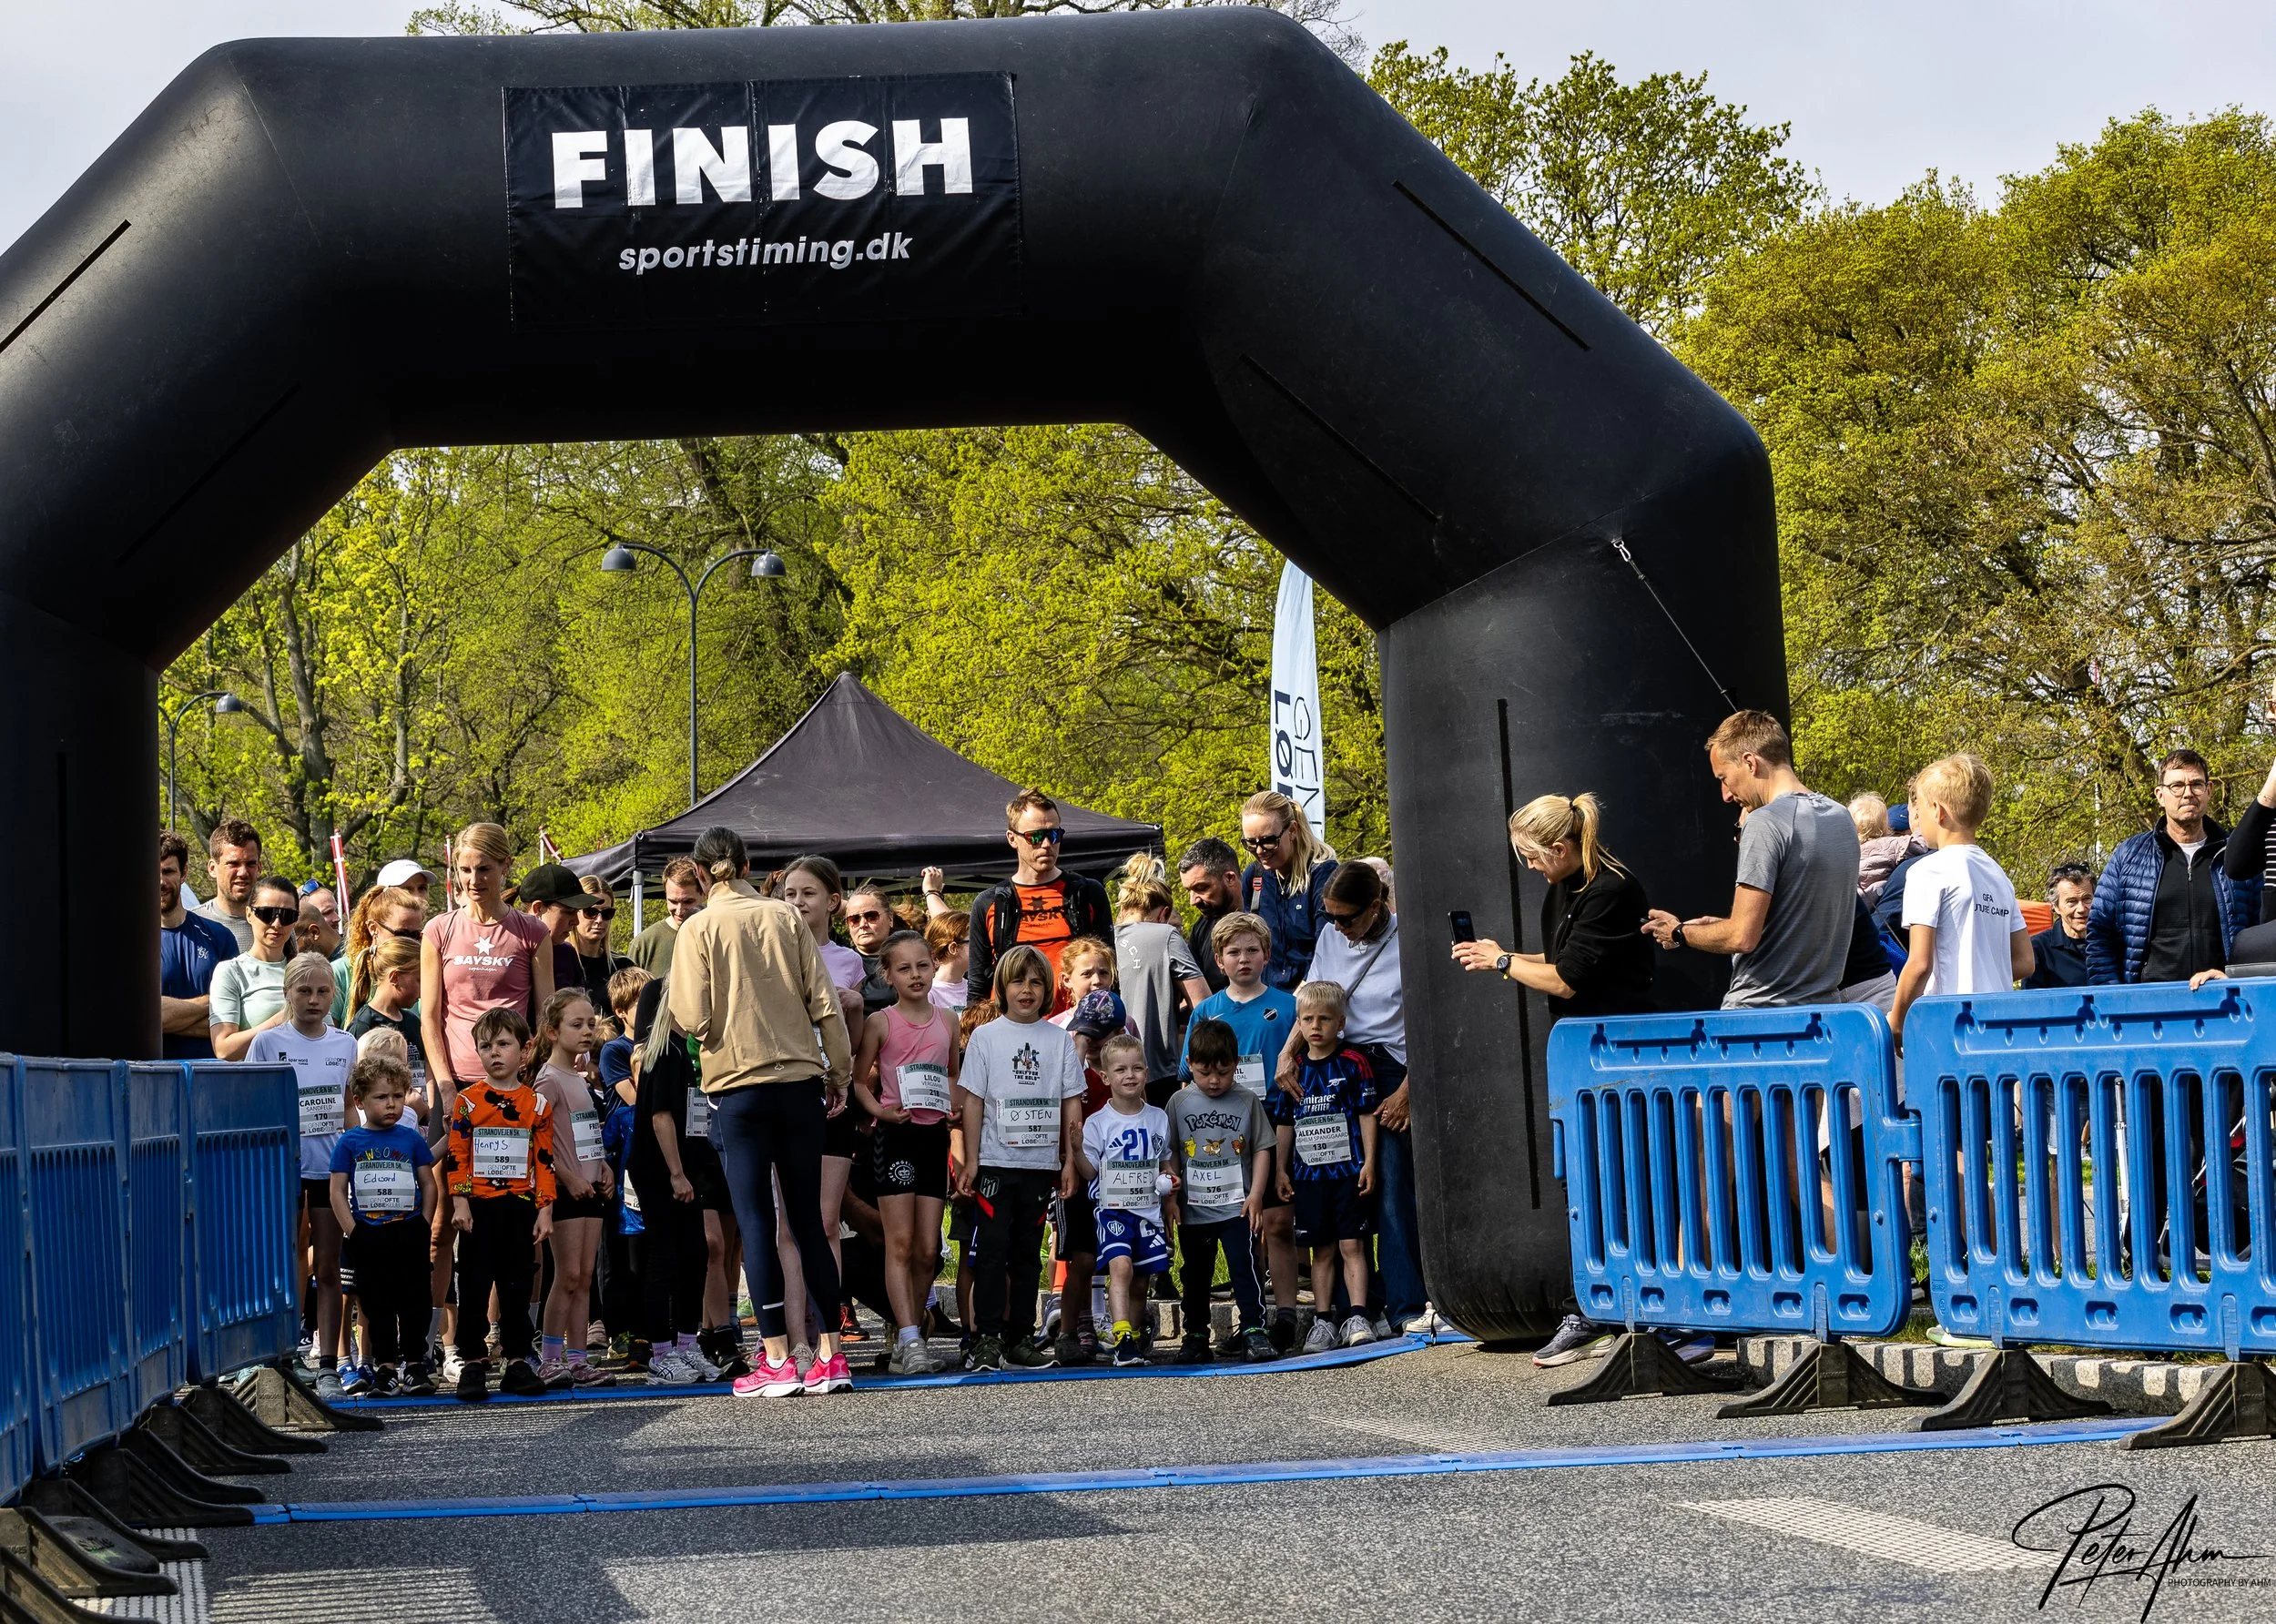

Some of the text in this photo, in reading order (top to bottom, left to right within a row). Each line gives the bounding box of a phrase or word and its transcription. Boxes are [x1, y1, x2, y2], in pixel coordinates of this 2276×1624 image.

[552, 117, 974, 208] FINISH
[618, 232, 913, 275] sportstiming.dk
[1991, 907, 2009, 917] CAMP
[454, 956, 513, 967] SAYSKY
[300, 1087, 327, 1095] RANDVEJEN
[300, 1097, 337, 1107] CAROLINE
[1299, 1094, 1336, 1106] Emirates
[1298, 1126, 1341, 1138] ALEXANDER
[1122, 1128, 1149, 1161] 21
[1313, 1142, 1327, 1151] 130
[494, 1155, 510, 1163] 589
[1113, 1172, 1153, 1185] ALFRED
[1192, 1170, 1222, 1182] AXEL
[1129, 1187, 1143, 1195] 556
[1206, 1185, 1222, 1193] 576
